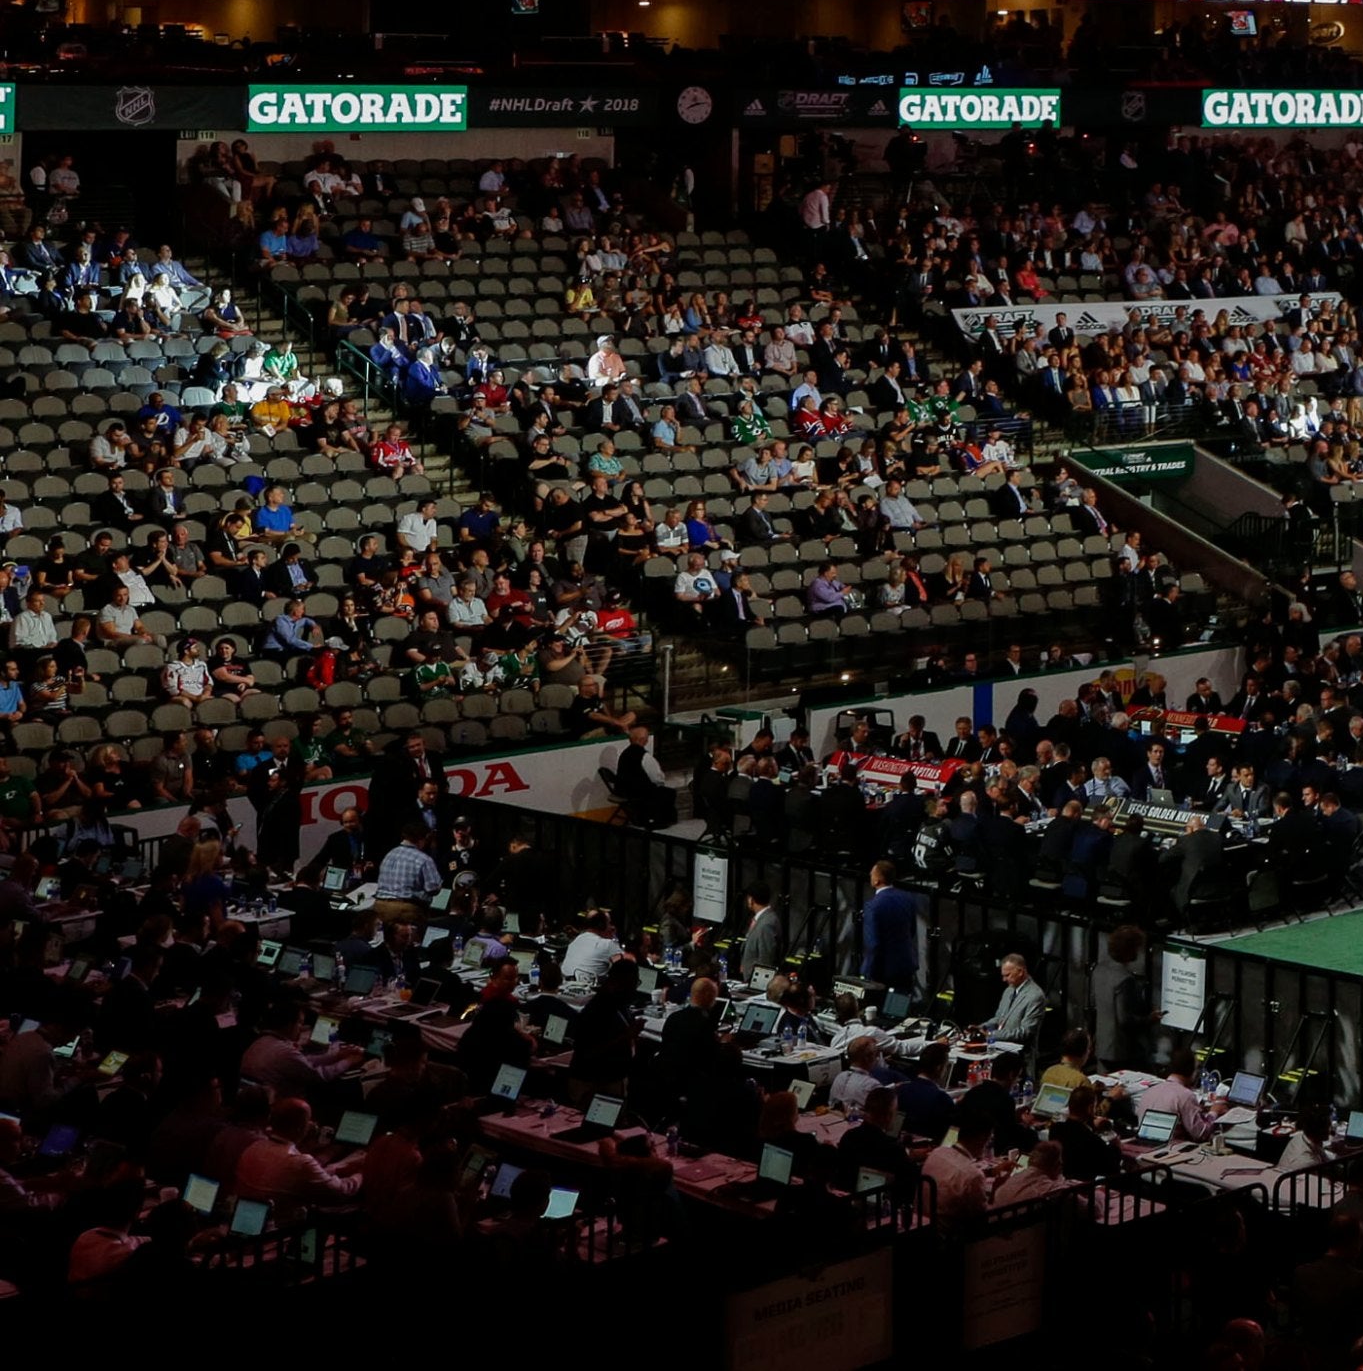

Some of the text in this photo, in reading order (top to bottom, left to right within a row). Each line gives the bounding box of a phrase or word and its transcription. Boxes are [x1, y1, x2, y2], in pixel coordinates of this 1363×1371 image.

[124, 98, 148, 116] NHL
[249, 92, 463, 124] GATORADE
[489, 97, 639, 113] #NHLDraft 2018
[796, 94, 848, 106] DRAFT
[900, 95, 1057, 124] GATORADE
[1156, 462, 1186, 473] TRADES
[910, 765, 942, 781] CAPITALS
[1127, 802, 1148, 818] VEGAS
[1147, 806, 1178, 822] GOLDEN
